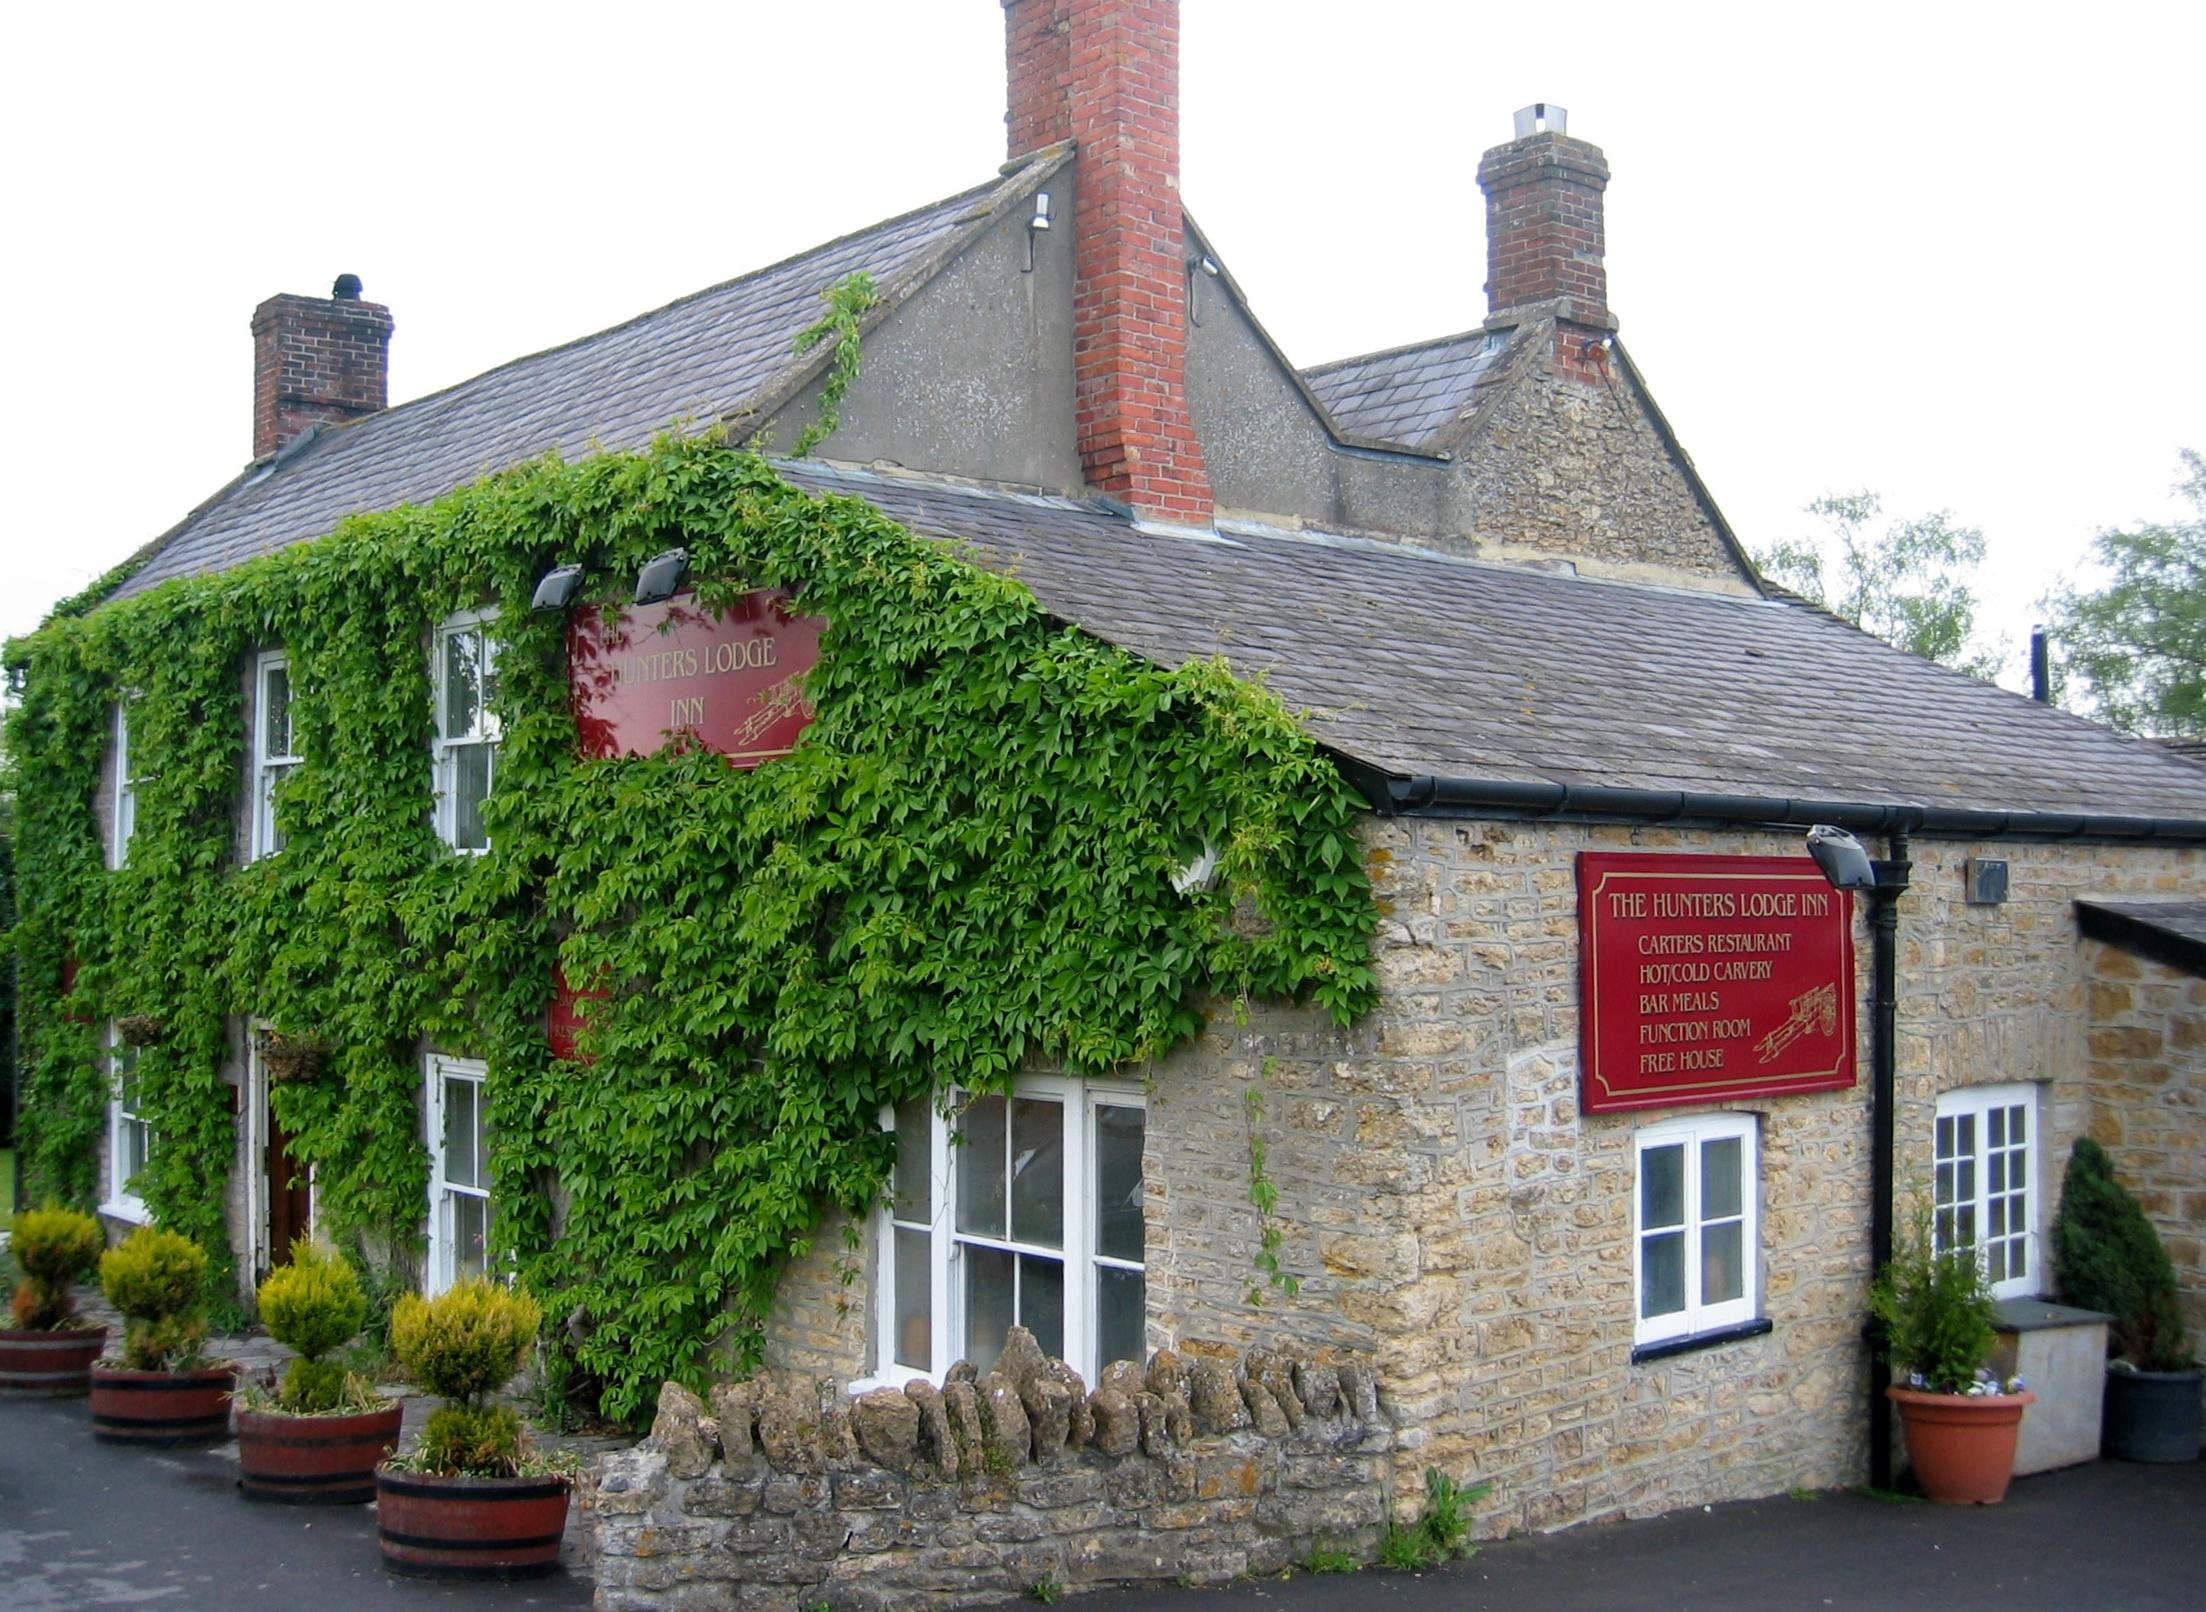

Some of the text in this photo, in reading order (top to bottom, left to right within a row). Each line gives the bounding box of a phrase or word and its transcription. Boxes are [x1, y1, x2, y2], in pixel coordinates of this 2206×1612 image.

[611, 637, 777, 685] HUNTERS LODGE
[671, 697, 705, 726] INN
[1608, 893, 1829, 917] THE HUNTERS LODGE INN
[1638, 933, 1792, 955] CARTERS RESTAURANT
[1640, 961, 1773, 985] HOT/COLD CARVERY
[1640, 992, 1719, 1014] BAR MEALS
[1640, 1019, 1751, 1044] FUNCTION ROOM
[1640, 1049, 1724, 1074] FREE HOUSE
